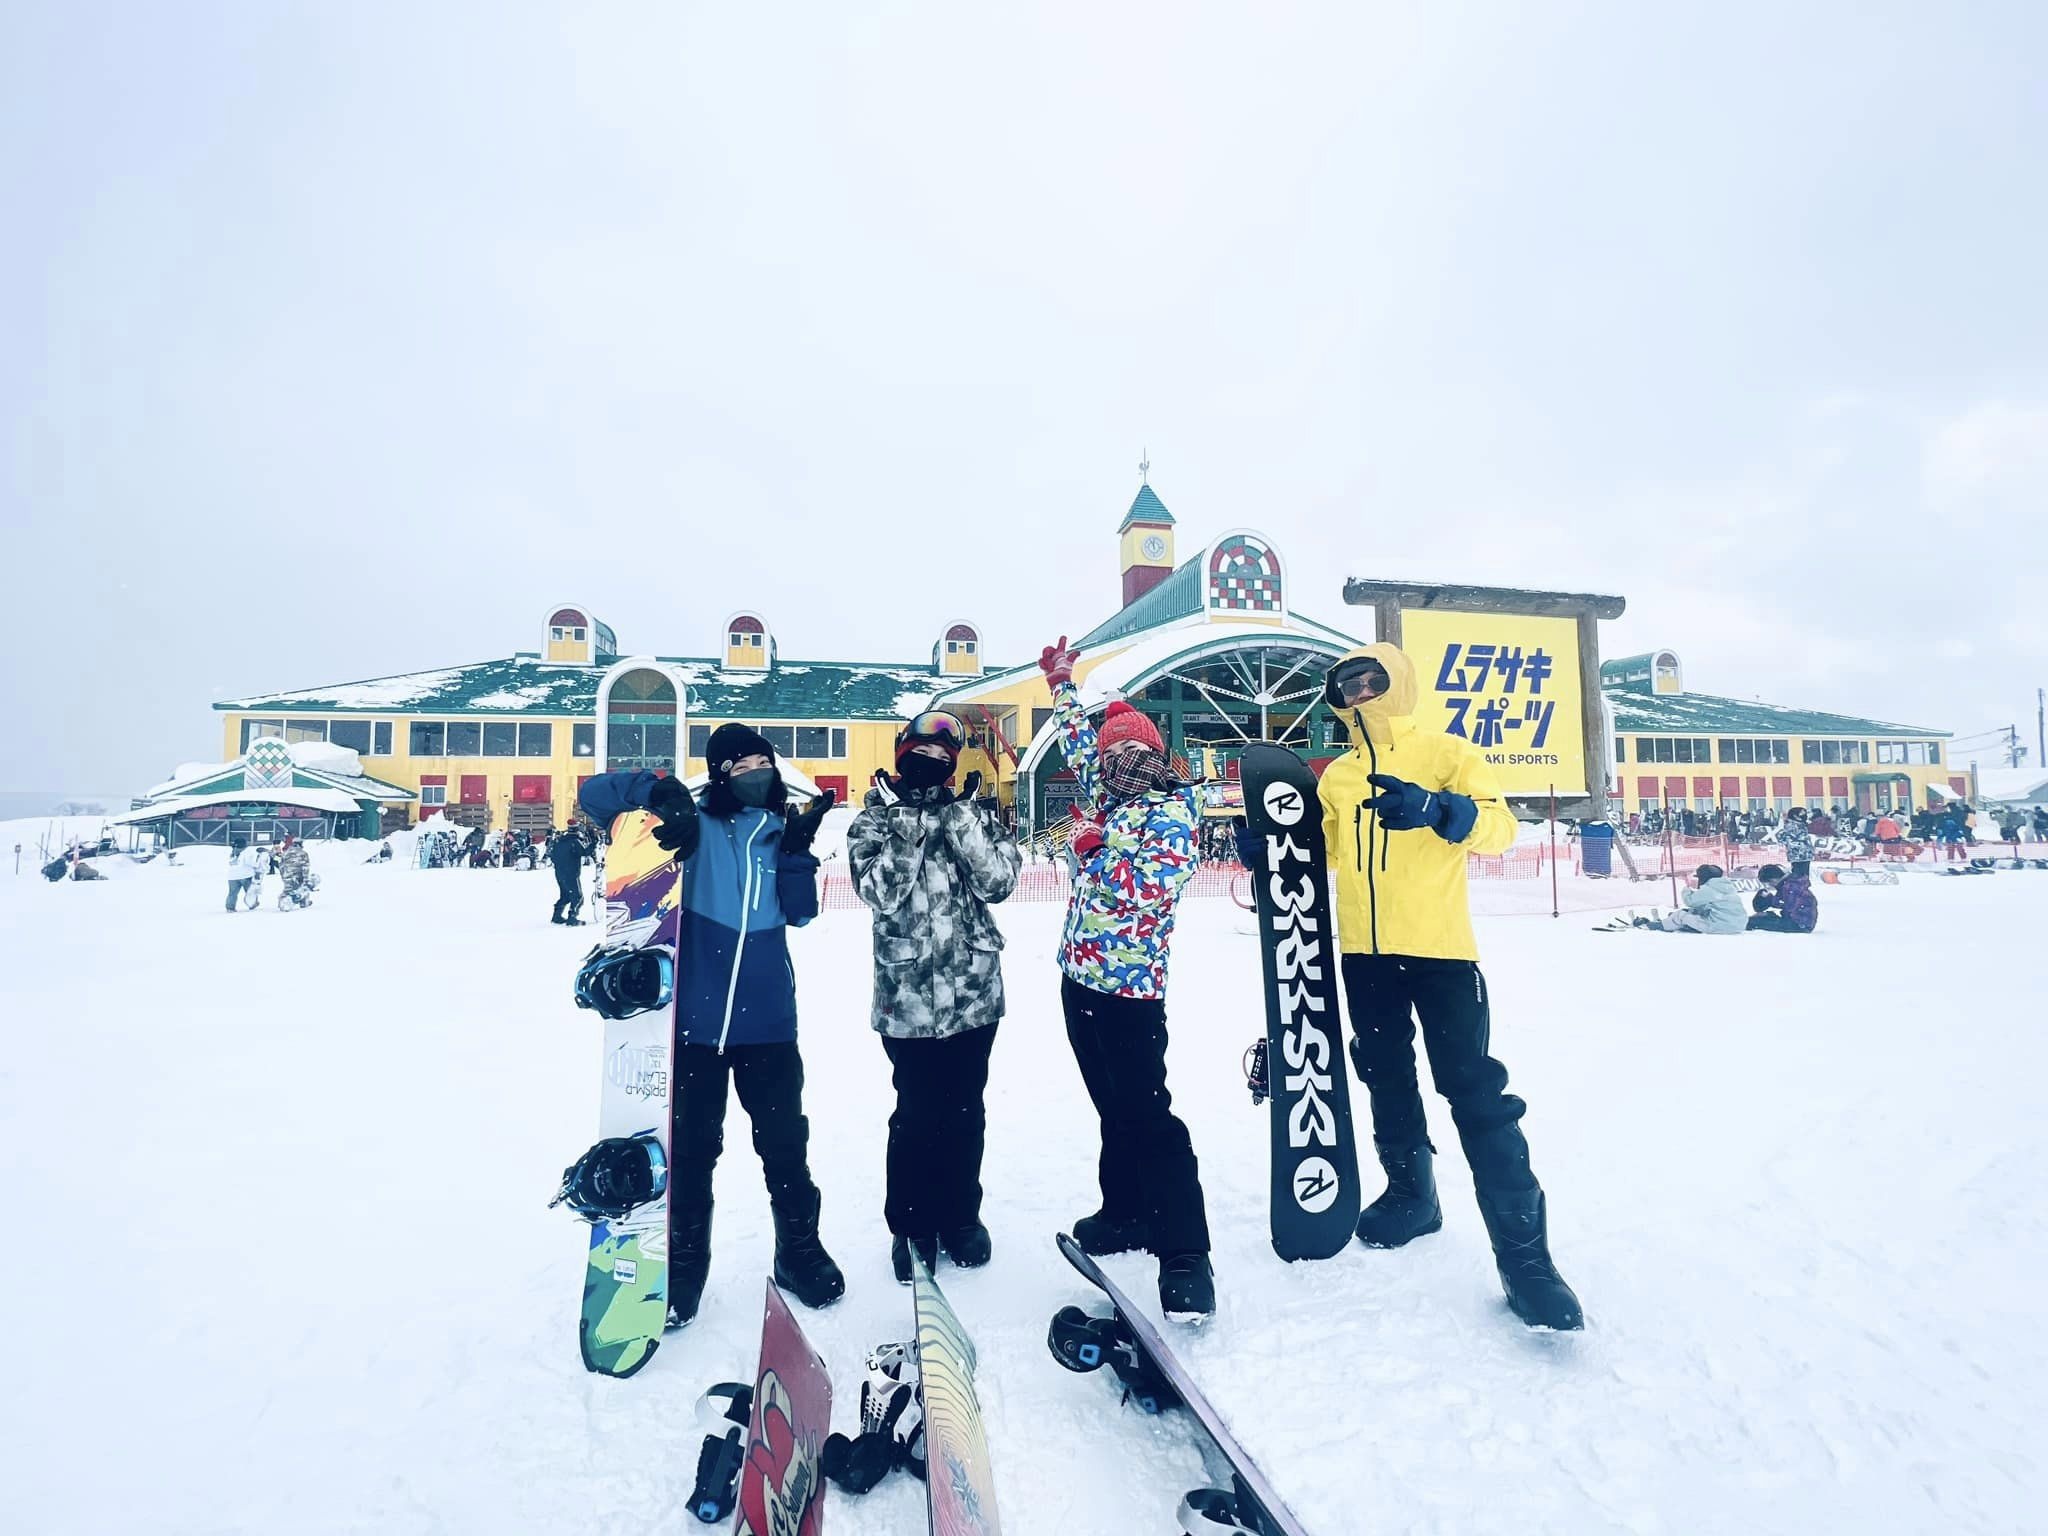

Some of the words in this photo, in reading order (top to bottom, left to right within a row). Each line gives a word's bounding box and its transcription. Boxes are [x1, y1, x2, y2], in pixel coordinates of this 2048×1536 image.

[1434, 643, 1553, 694] ムラサキ
[1444, 697, 1556, 749] スポーツ
[1485, 753, 1505, 765] AKI
[1509, 753, 1558, 765] SPORTS
[1266, 831, 1337, 1149] DISTRICT
